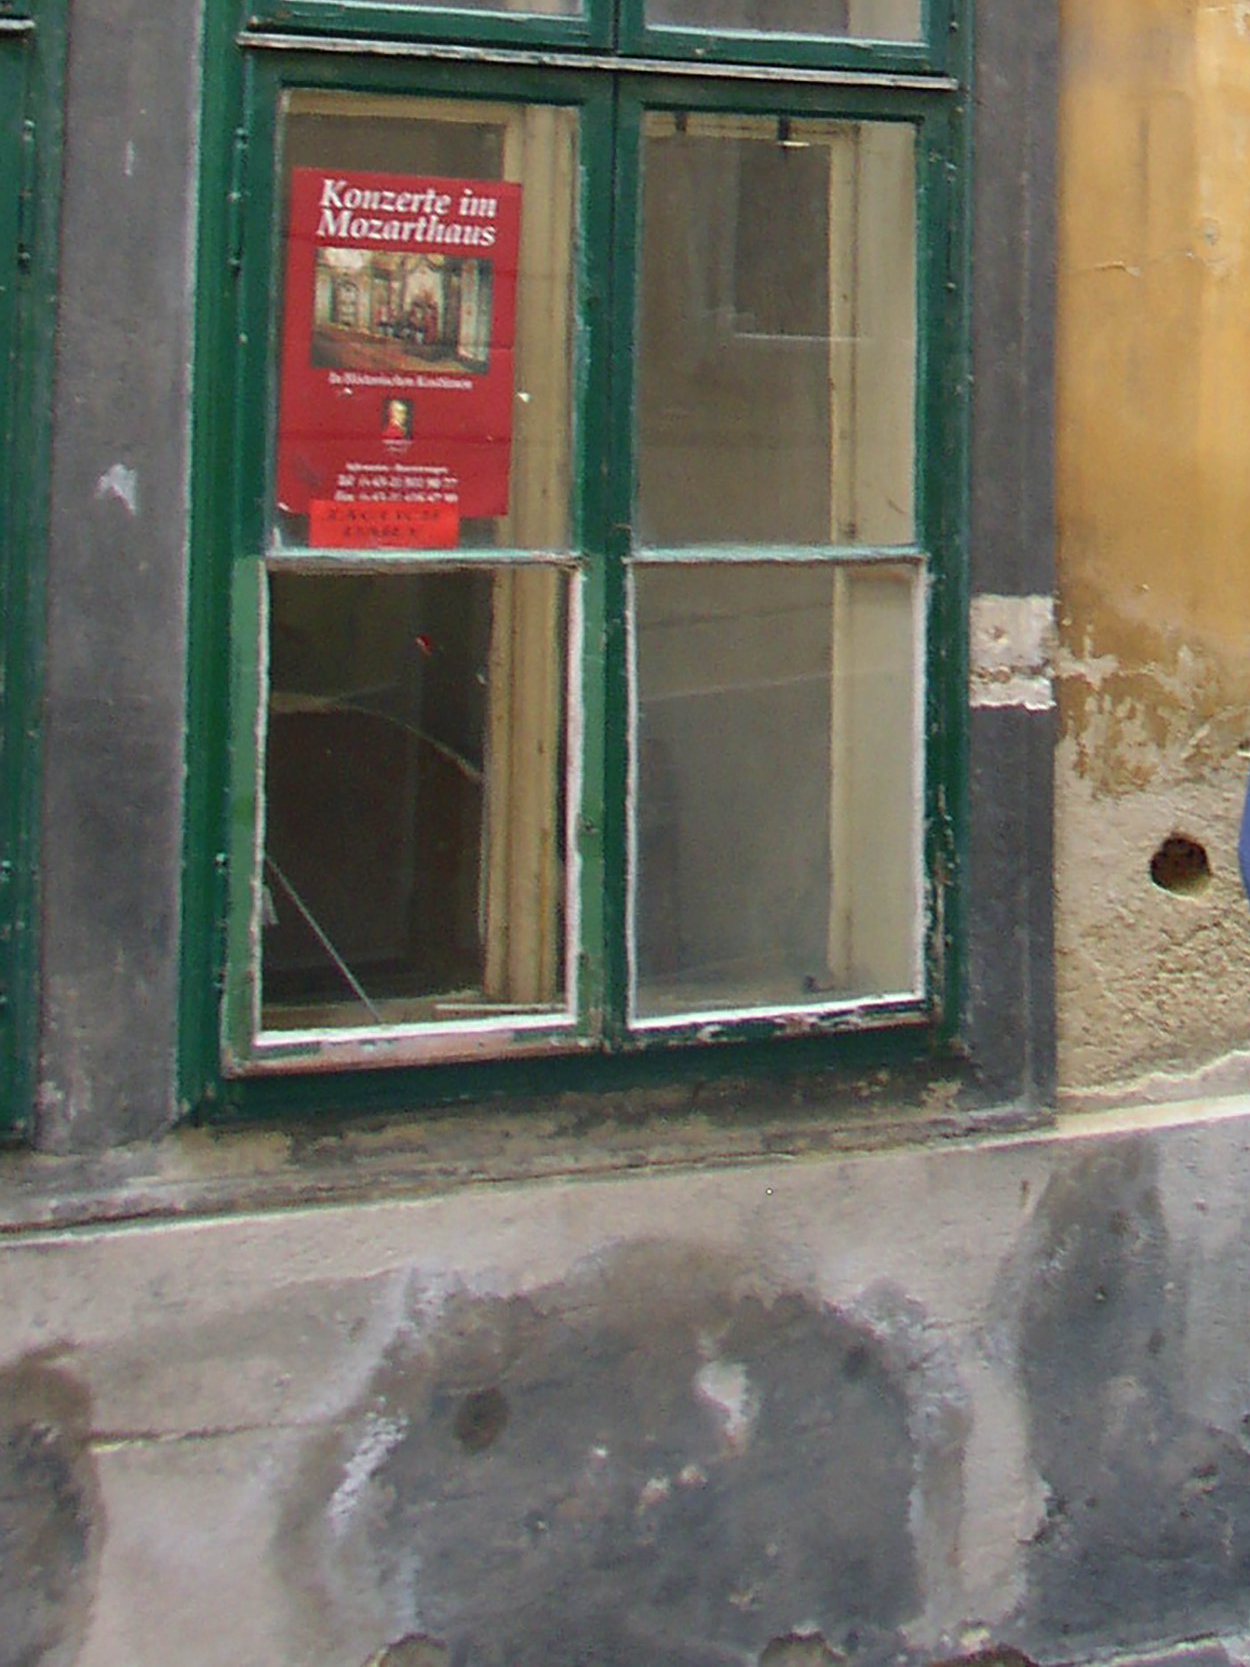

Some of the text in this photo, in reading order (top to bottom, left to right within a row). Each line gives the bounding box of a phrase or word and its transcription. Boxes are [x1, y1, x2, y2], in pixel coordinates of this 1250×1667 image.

[319, 178, 498, 219] Konzerte im
[315, 206, 497, 247] Mozarthaus
